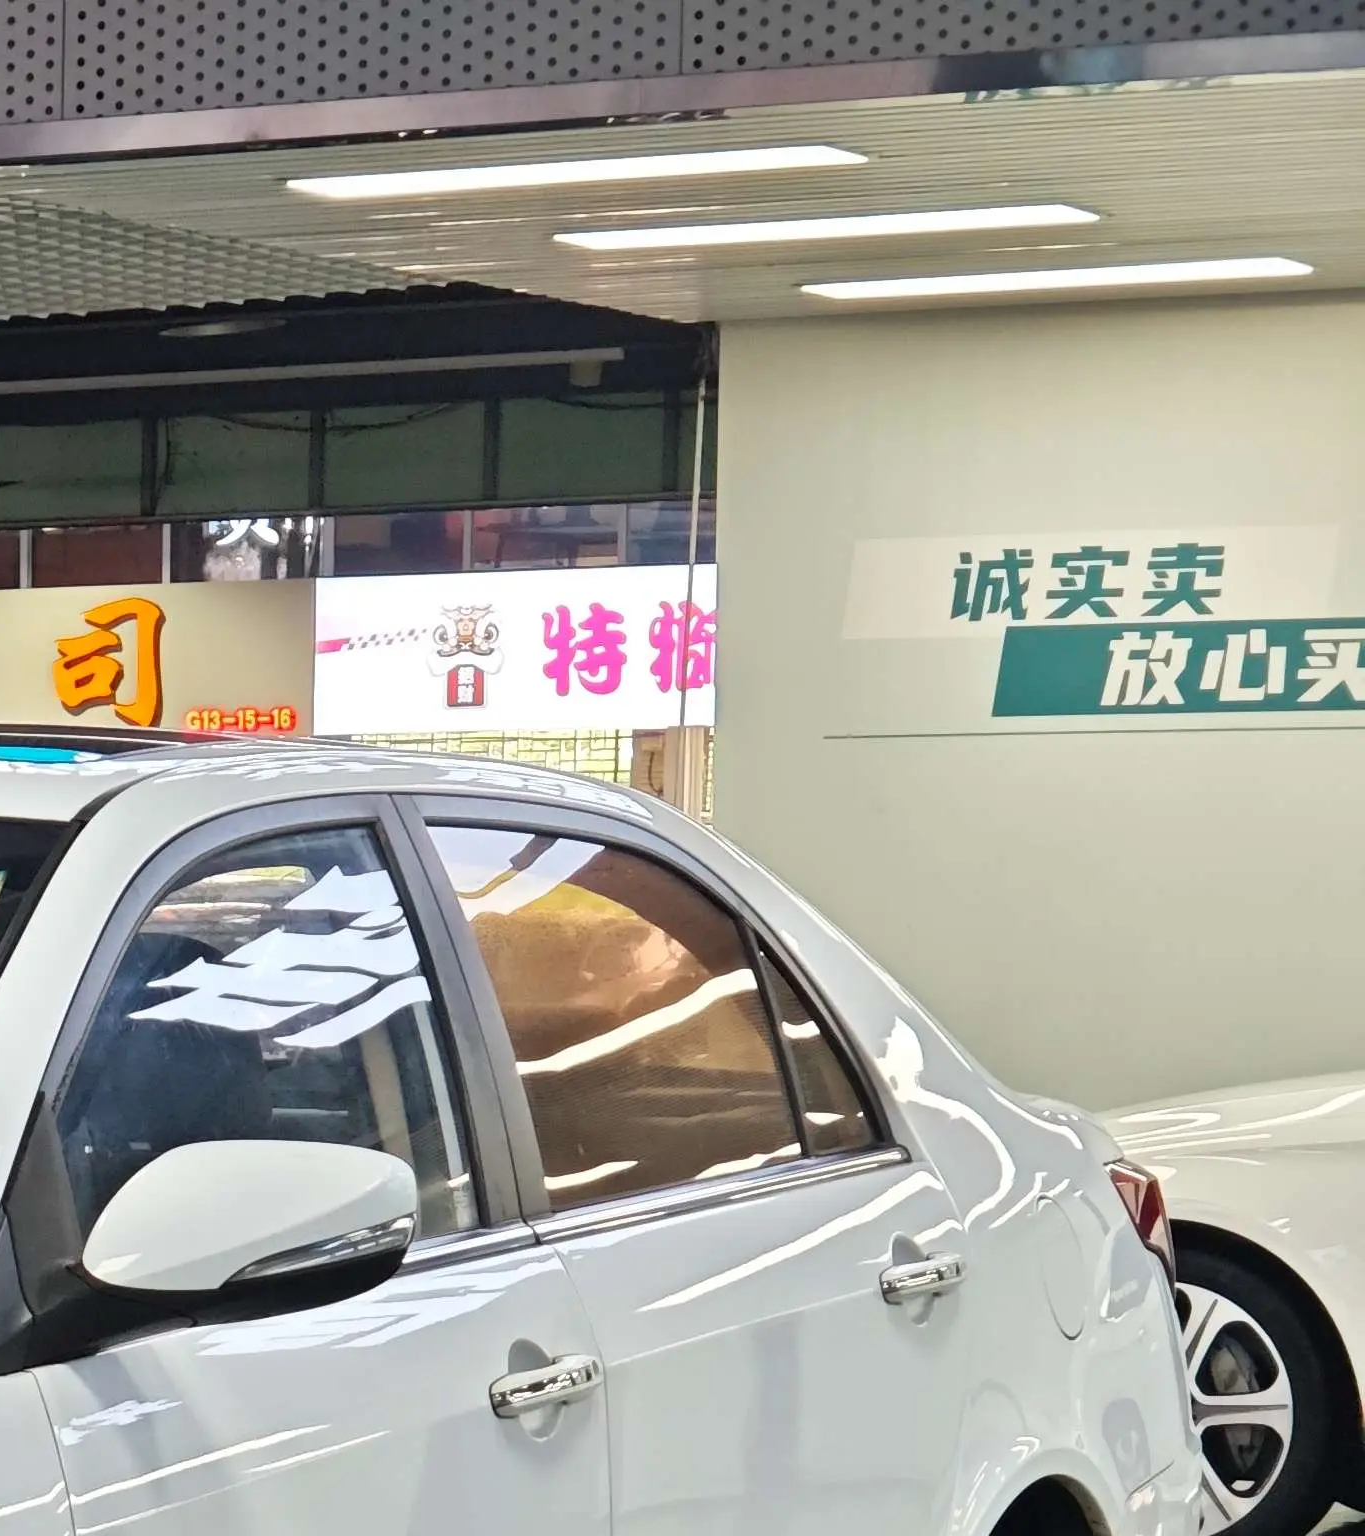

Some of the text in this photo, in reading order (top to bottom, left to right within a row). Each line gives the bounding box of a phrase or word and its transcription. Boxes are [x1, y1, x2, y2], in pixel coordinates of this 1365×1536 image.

[949, 542, 1226, 622] 诚实卖
[1100, 628, 1365, 707] 放心买
[185, 707, 296, 731] G13-15-16
